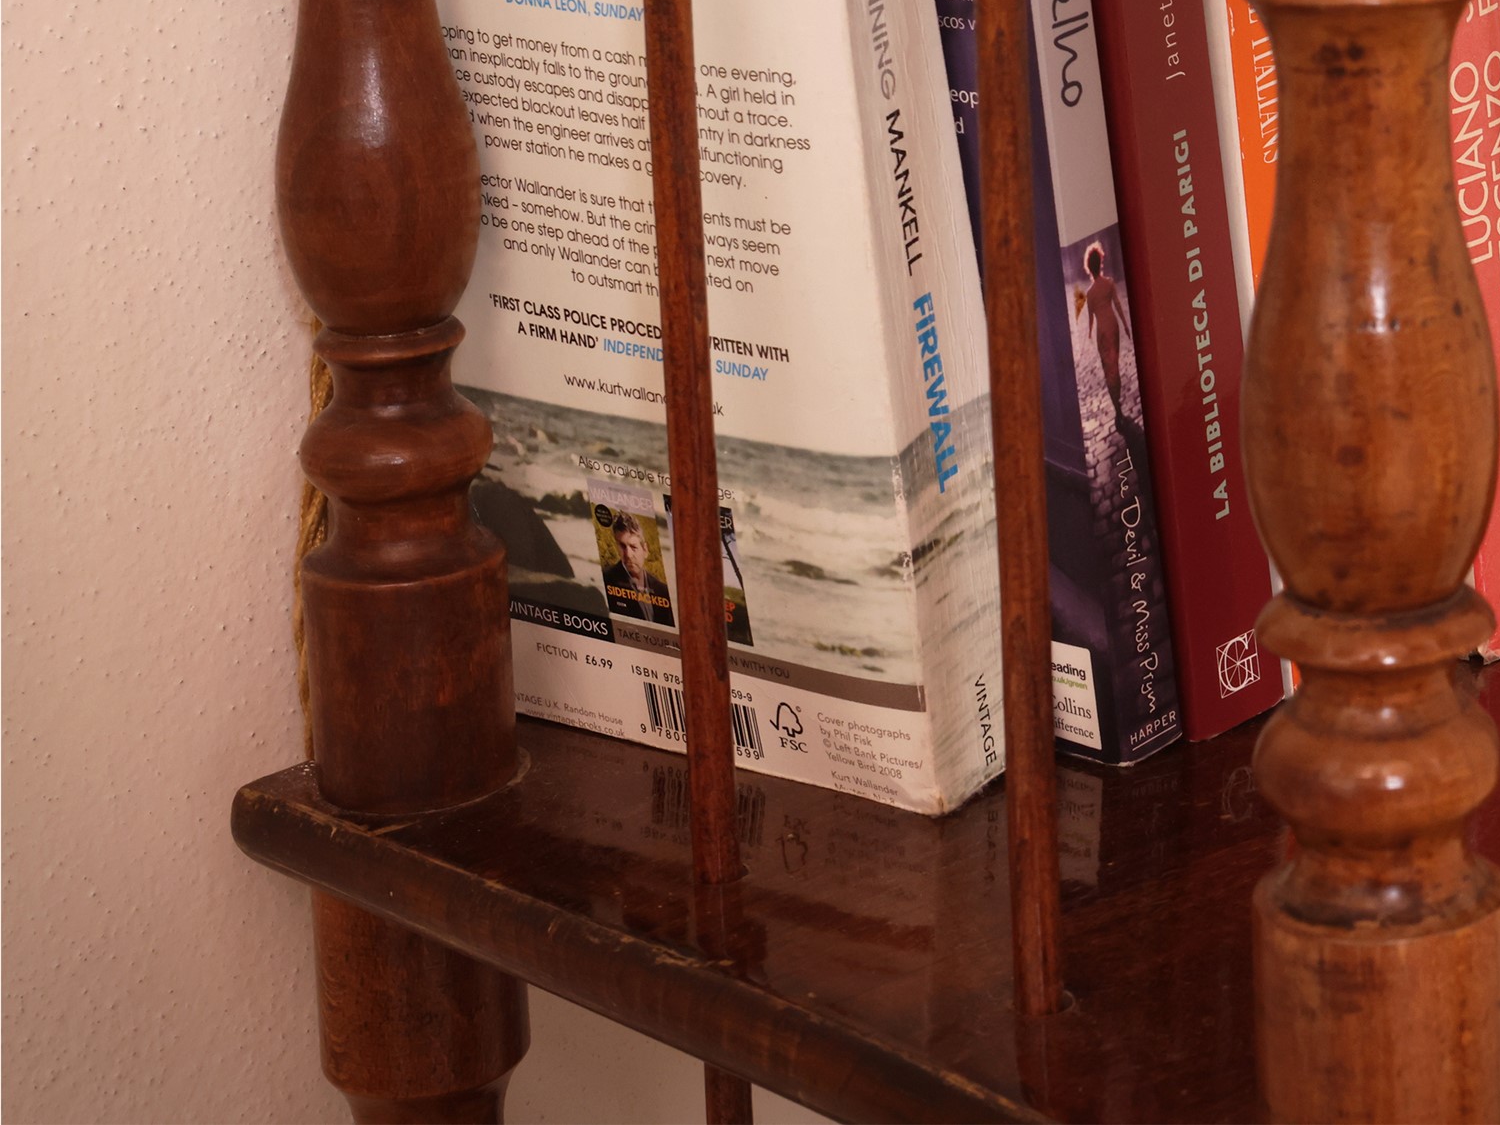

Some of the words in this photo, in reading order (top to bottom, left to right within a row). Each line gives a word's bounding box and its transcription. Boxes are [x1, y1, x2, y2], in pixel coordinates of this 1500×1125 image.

[594, 2, 644, 22] SUNDAY
[469, 48, 540, 75] inexplicably
[720, 87, 741, 104] girl
[516, 37, 558, 58] money
[560, 42, 589, 60] from
[605, 49, 636, 67] cash
[731, 67, 797, 87] evening,
[474, 70, 521, 93] custody
[524, 80, 575, 100] escapes
[747, 110, 793, 128] trace.
[521, 97, 576, 120] blackout
[578, 108, 619, 127] leaves
[743, 131, 811, 151] darkness
[536, 122, 591, 141] engineer
[593, 132, 635, 150] arrives
[484, 133, 522, 151] power
[525, 139, 567, 159] station
[588, 152, 630, 170] makes
[1450, 62, 1494, 266] LUCIANO
[1173, 128, 1199, 236] PARIGI
[514, 177, 576, 201] Wallander
[734, 217, 766, 233] must
[521, 201, 584, 223] somehow.
[537, 223, 564, 242] step
[567, 229, 609, 248] ahead
[706, 254, 736, 270] next
[739, 259, 780, 276] move
[558, 246, 621, 270] Wallander
[1187, 244, 1204, 282] DI
[587, 274, 643, 294] outsmart
[885, 108, 924, 278] MANKELL
[911, 291, 960, 493] FIREWALL
[523, 300, 561, 321] CLASS
[563, 308, 608, 330] POLICE
[755, 343, 790, 363] WITH
[529, 323, 557, 342] FIRM
[715, 359, 769, 381] SUNDAY
[1193, 288, 1227, 475] BIBLIOTECA
[578, 455, 600, 471] Also
[603, 462, 655, 484] available
[1112, 448, 1137, 500] The
[1213, 477, 1231, 520] LA
[1119, 501, 1143, 562] Devil
[607, 584, 670, 608] SIDETRACKED
[1130, 571, 1145, 593] &
[509, 600, 560, 624] VINTAGE
[563, 613, 609, 636] BOOKS
[1132, 594, 1151, 654] Miss
[536, 642, 578, 661] FICTION
[585, 655, 613, 670] £6.99
[631, 664, 659, 680] ISBN
[741, 658, 766, 674] WITH
[767, 664, 790, 679] YOU
[1139, 651, 1160, 714] Prym
[564, 703, 596, 719] Random
[599, 713, 623, 726] House
[817, 712, 845, 727] Cover
[848, 720, 911, 742] photographs
[973, 672, 999, 767] VINTAGE
[1129, 710, 1177, 746] HARPER
[779, 737, 809, 755] FSC
[854, 734, 872, 747] Fisk
[855, 746, 877, 761] Bank
[880, 751, 923, 770] Pictures/
[826, 750, 855, 767] Yellow
[857, 758, 876, 773] Bird
[879, 764, 902, 780] 2008
[831, 769, 850, 785] Kurt
[853, 774, 898, 797] Wallander
